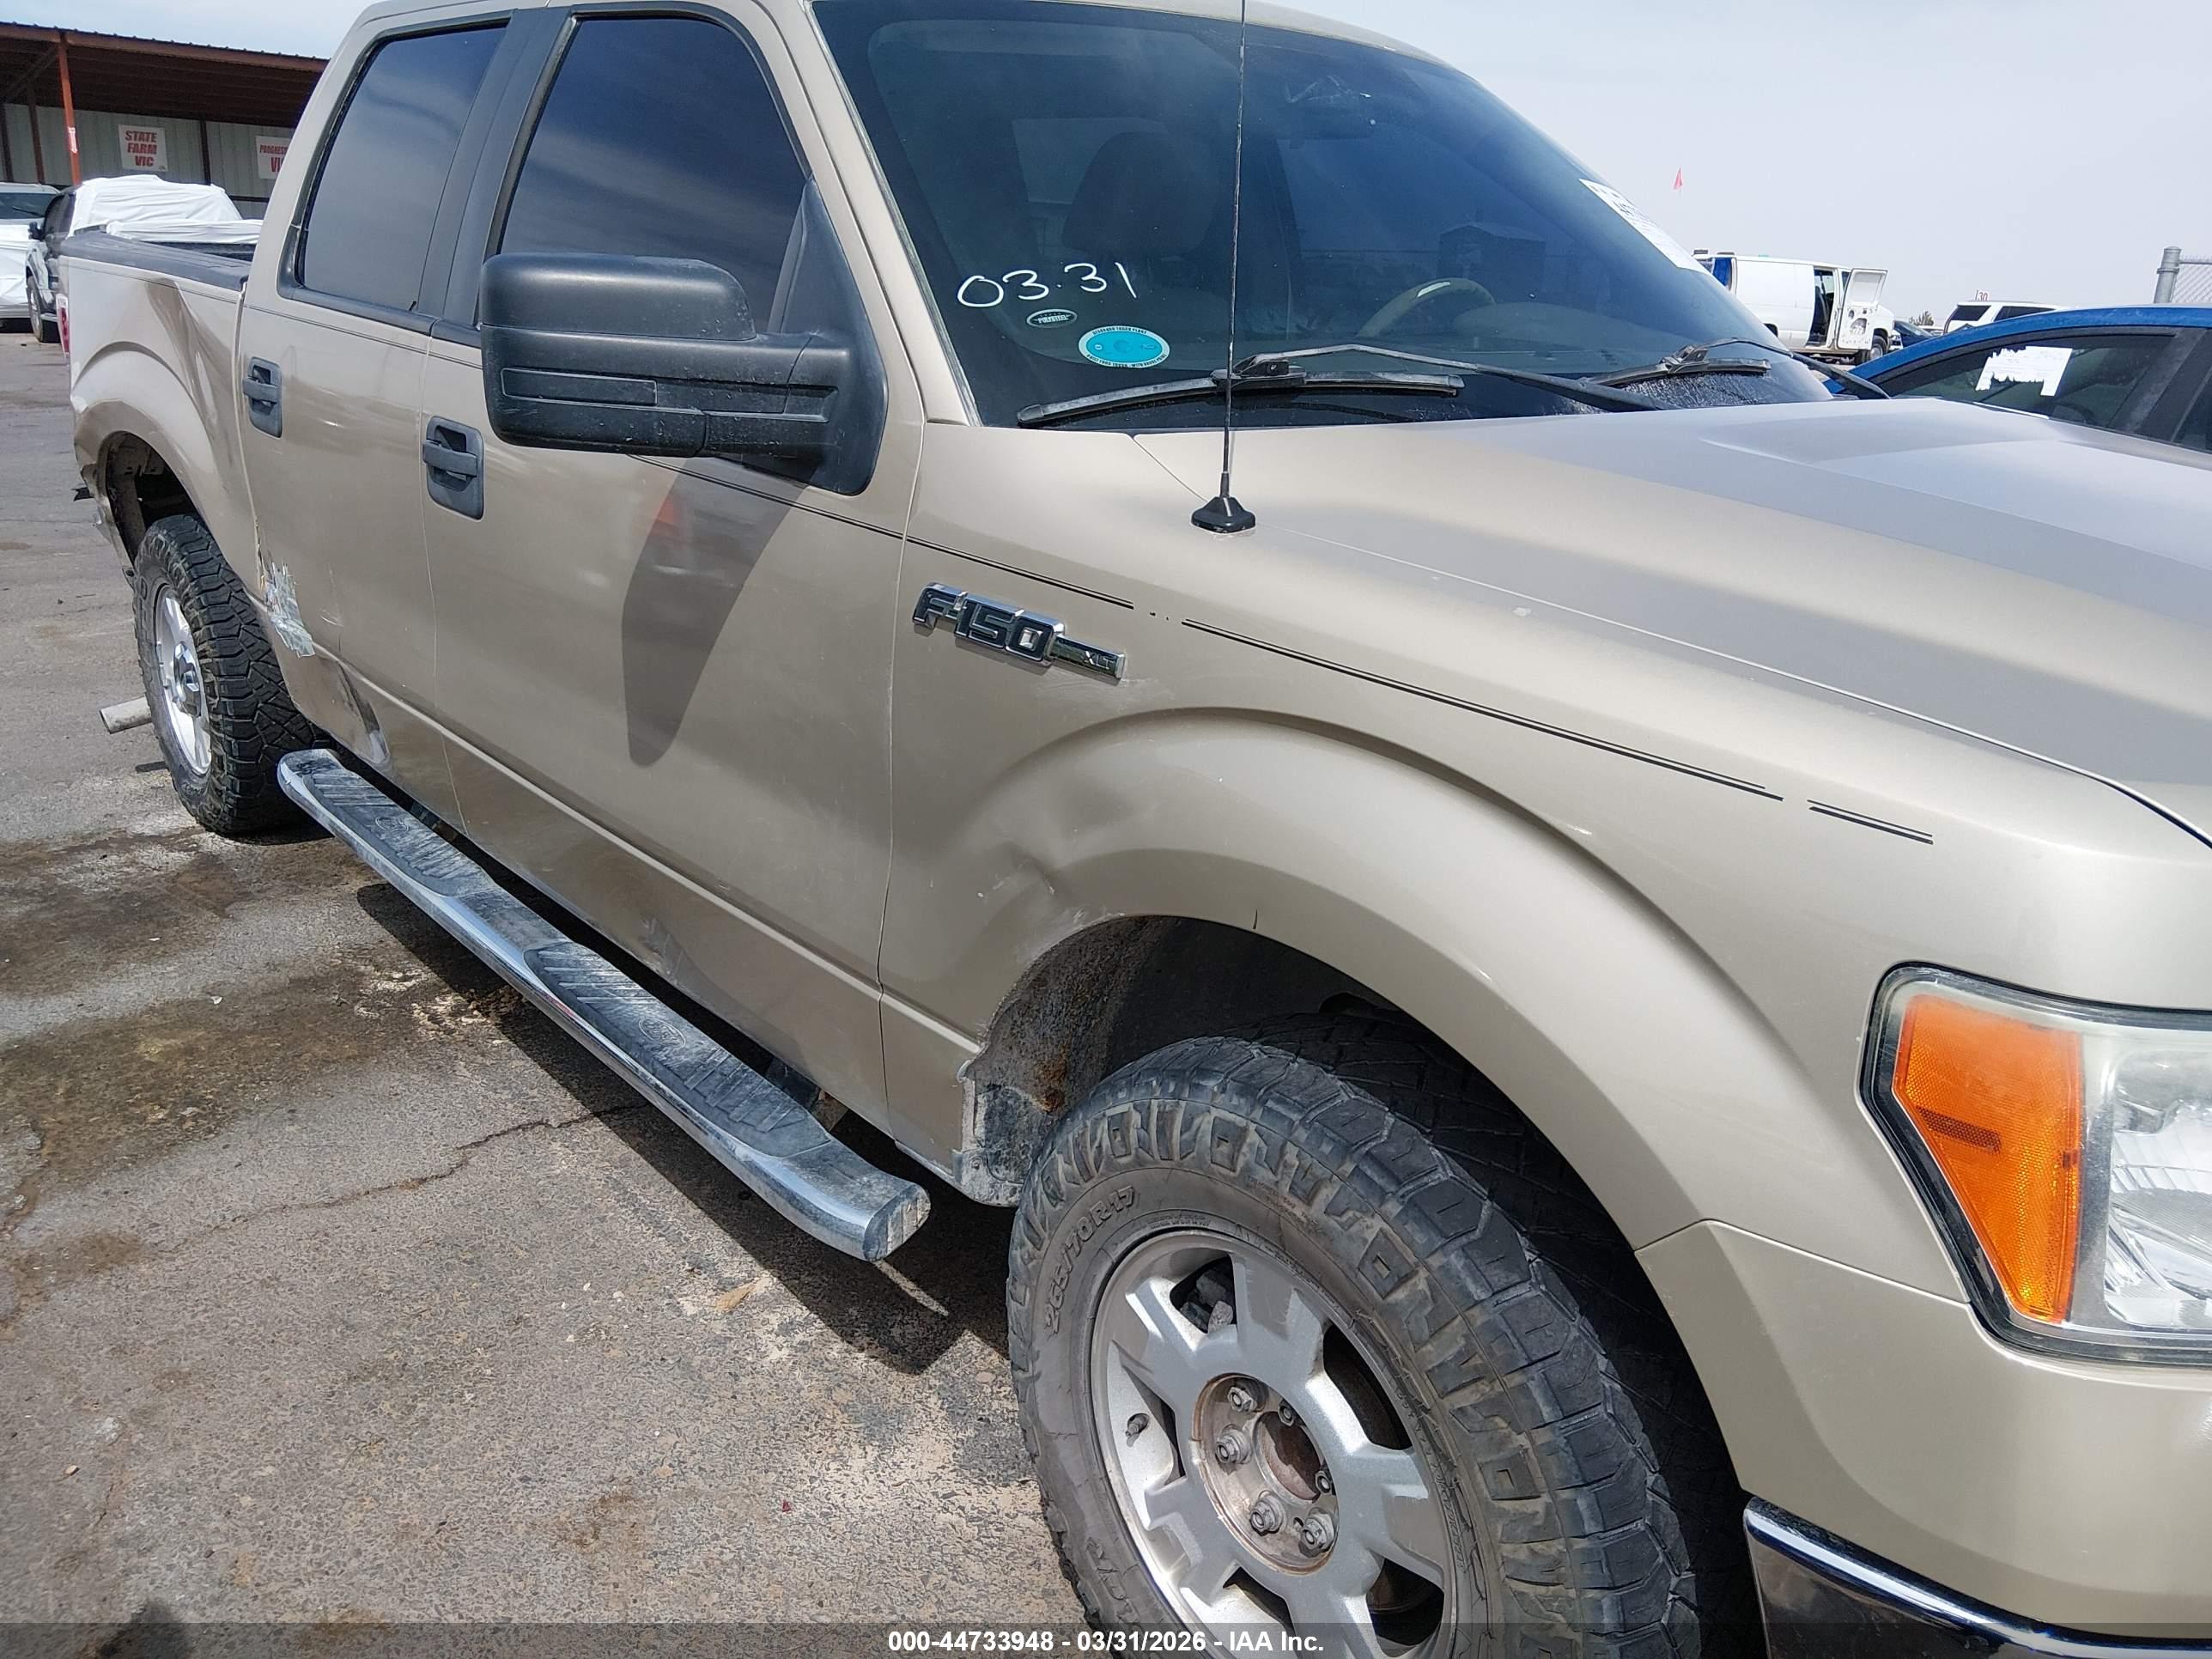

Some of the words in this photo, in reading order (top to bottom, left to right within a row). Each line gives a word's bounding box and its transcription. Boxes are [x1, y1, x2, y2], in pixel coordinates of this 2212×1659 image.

[125, 130, 158, 143] STATE
[127, 142, 158, 155] FARM
[135, 155, 155, 167] VIC
[1083, 650, 1115, 671] XLT
